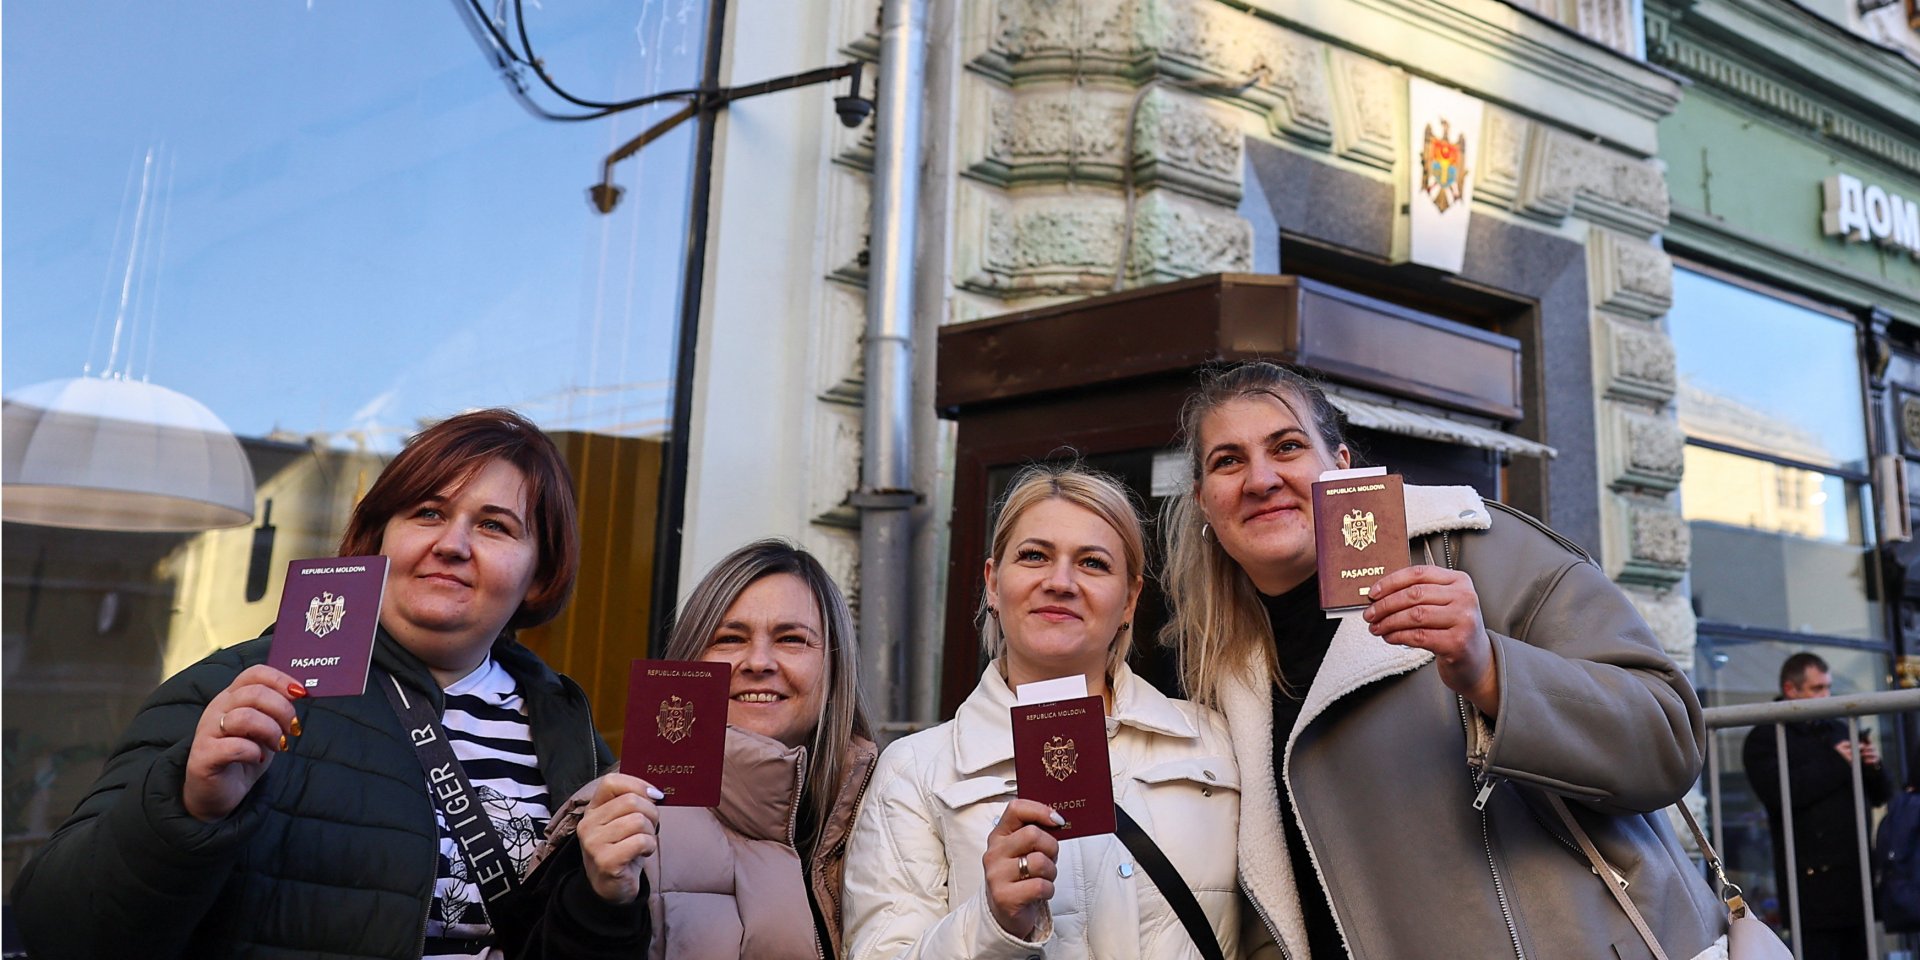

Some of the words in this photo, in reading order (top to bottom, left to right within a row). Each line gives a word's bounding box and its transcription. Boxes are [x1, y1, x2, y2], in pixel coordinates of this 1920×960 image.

[1838, 171, 1920, 252] ДОМ
[1326, 486, 1357, 496] REPUBLICA
[1357, 483, 1386, 493] MOLDOVA
[301, 567, 335, 575] REPUBLICA
[335, 565, 366, 574] MOLDOVA
[647, 669, 680, 677] REPUBLICA
[1026, 712, 1057, 721] REPUBLICA
[1058, 708, 1086, 717] MOLDOVA
